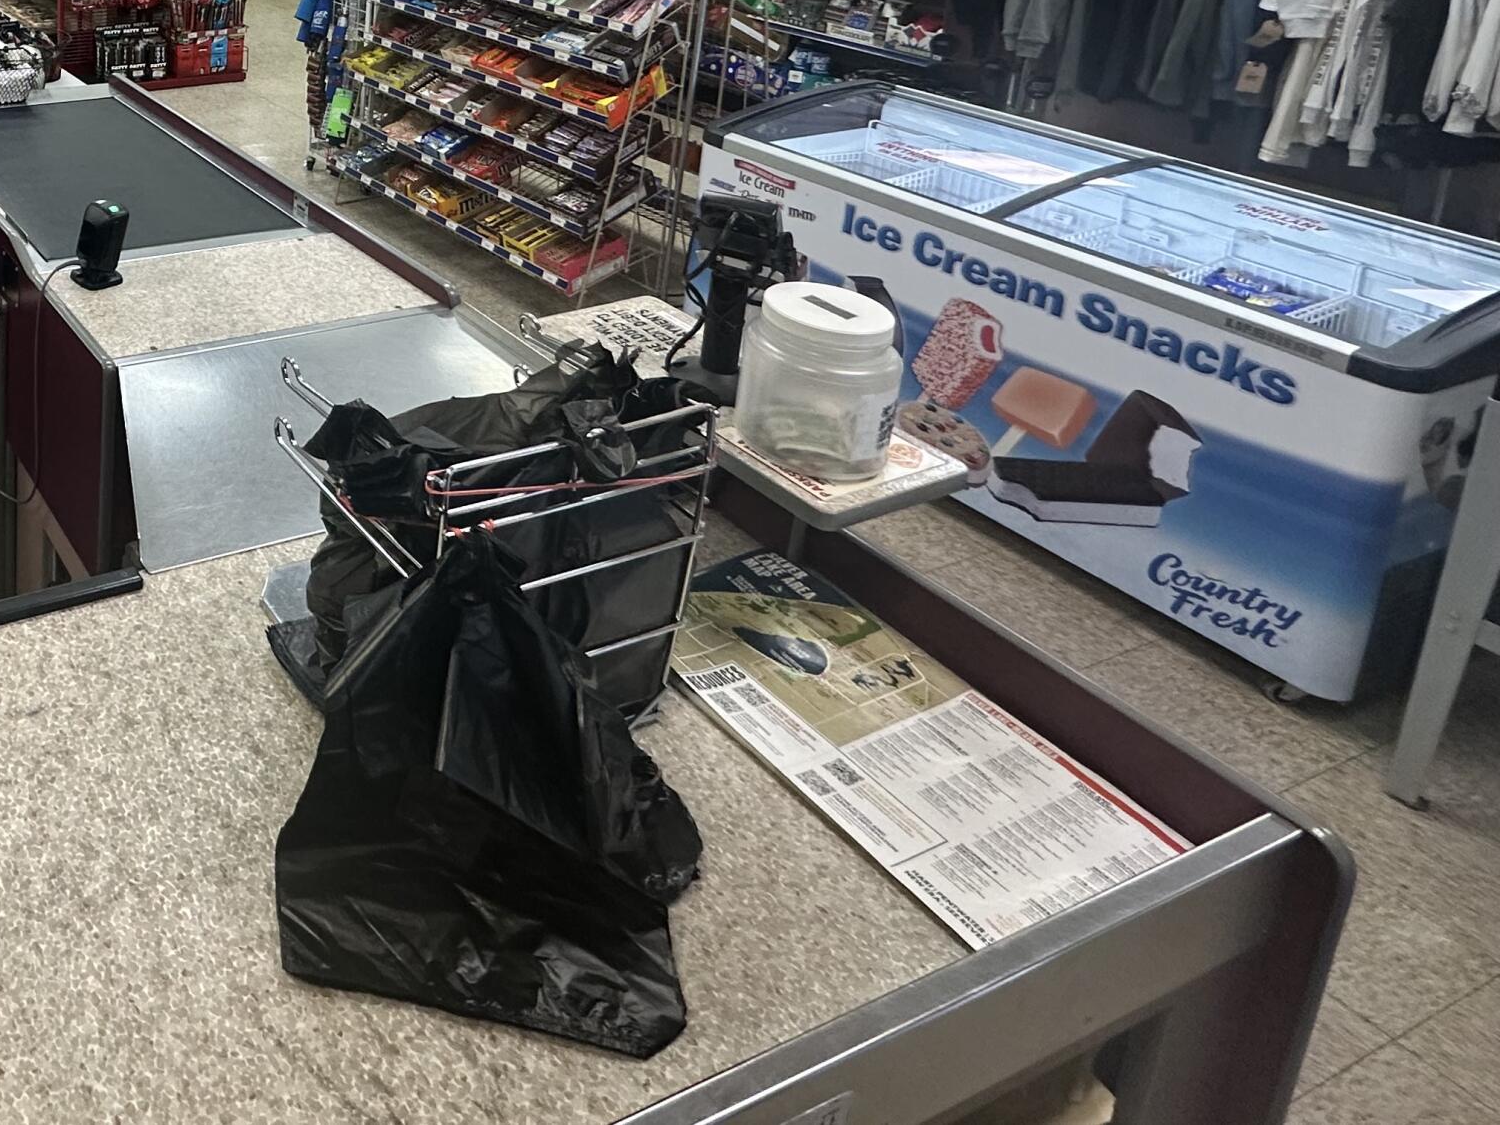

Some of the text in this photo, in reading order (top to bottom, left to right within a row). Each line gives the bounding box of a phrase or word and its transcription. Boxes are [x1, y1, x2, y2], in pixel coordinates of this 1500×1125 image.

[876, 141, 940, 163] ANYTHING
[739, 170, 753, 187] Ice
[754, 176, 786, 199] Cream
[611, 308, 648, 328] DEBIT
[842, 201, 1299, 407] Ice Cream Snacks
[611, 322, 651, 346] ADDED
[645, 341, 669, 353] BE
[741, 558, 775, 579] MAP
[753, 553, 784, 577] LAKE
[782, 577, 819, 601] AREA
[765, 550, 810, 581] SILVER
[1148, 552, 1304, 632] Country
[1167, 586, 1283, 650] Fresh
[684, 664, 747, 693] RESOURCES
[936, 890, 985, 934] PENTWATER
